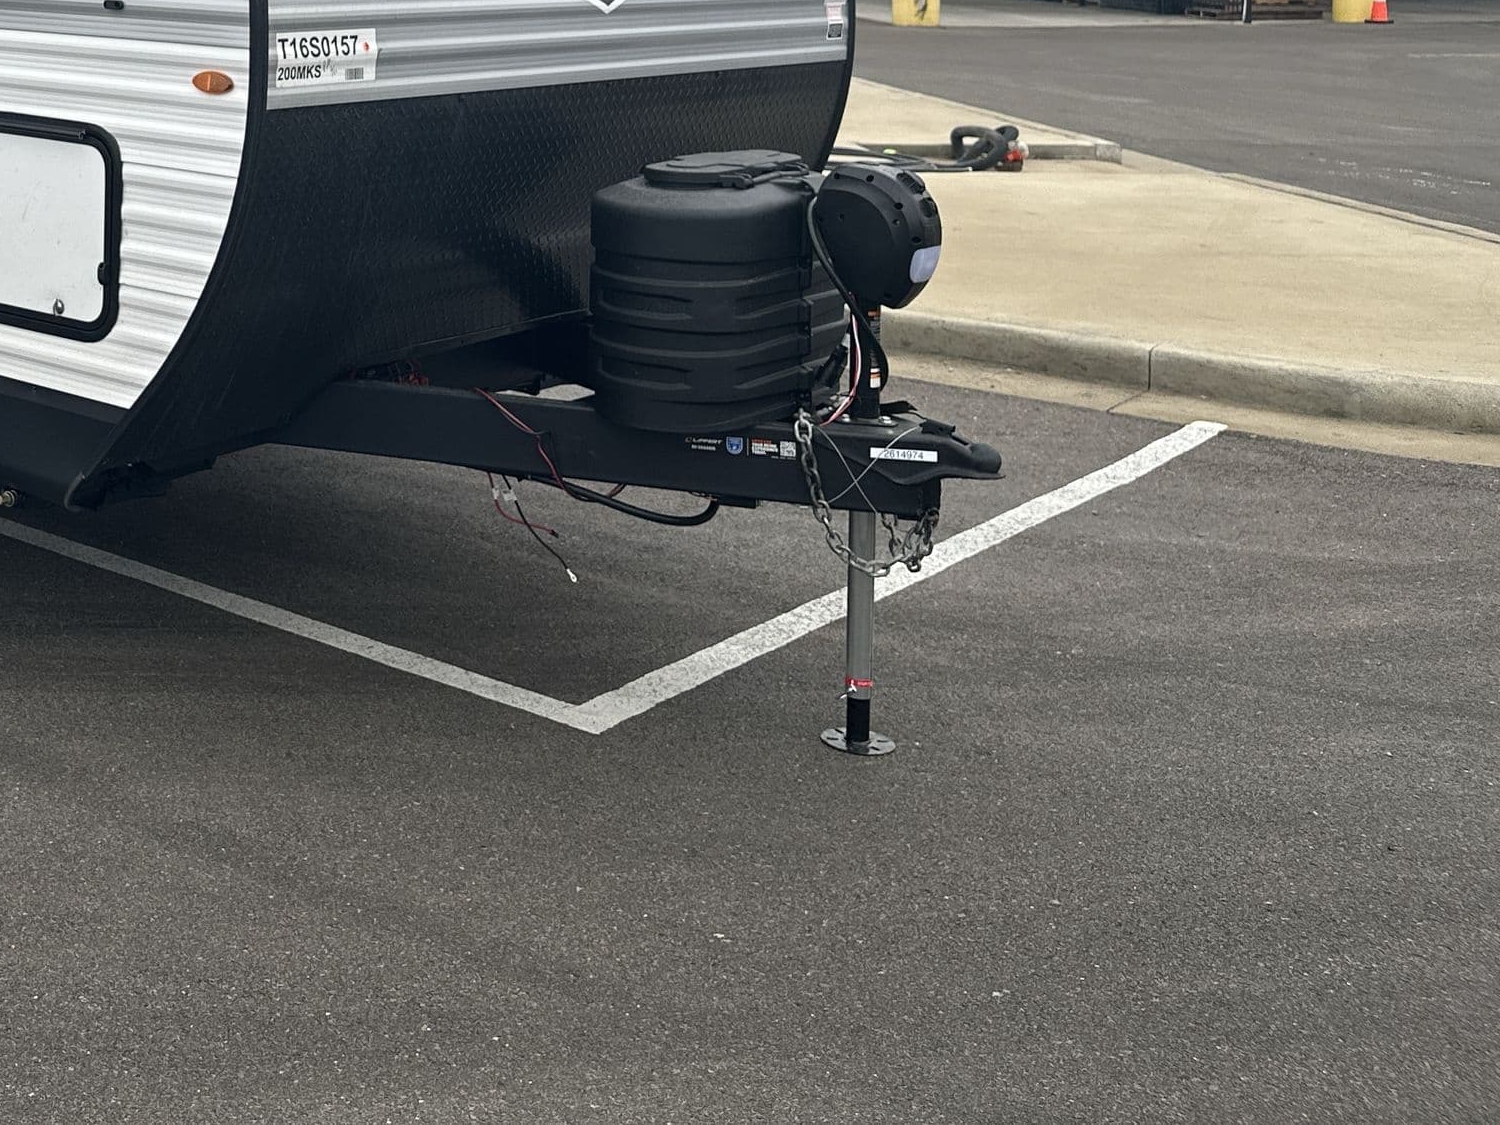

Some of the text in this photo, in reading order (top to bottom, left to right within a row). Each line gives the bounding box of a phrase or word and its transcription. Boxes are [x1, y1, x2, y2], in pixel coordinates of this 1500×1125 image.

[278, 35, 358, 60] T16S0157
[277, 64, 322, 81] 200MKS
[883, 449, 924, 460] 2614974
